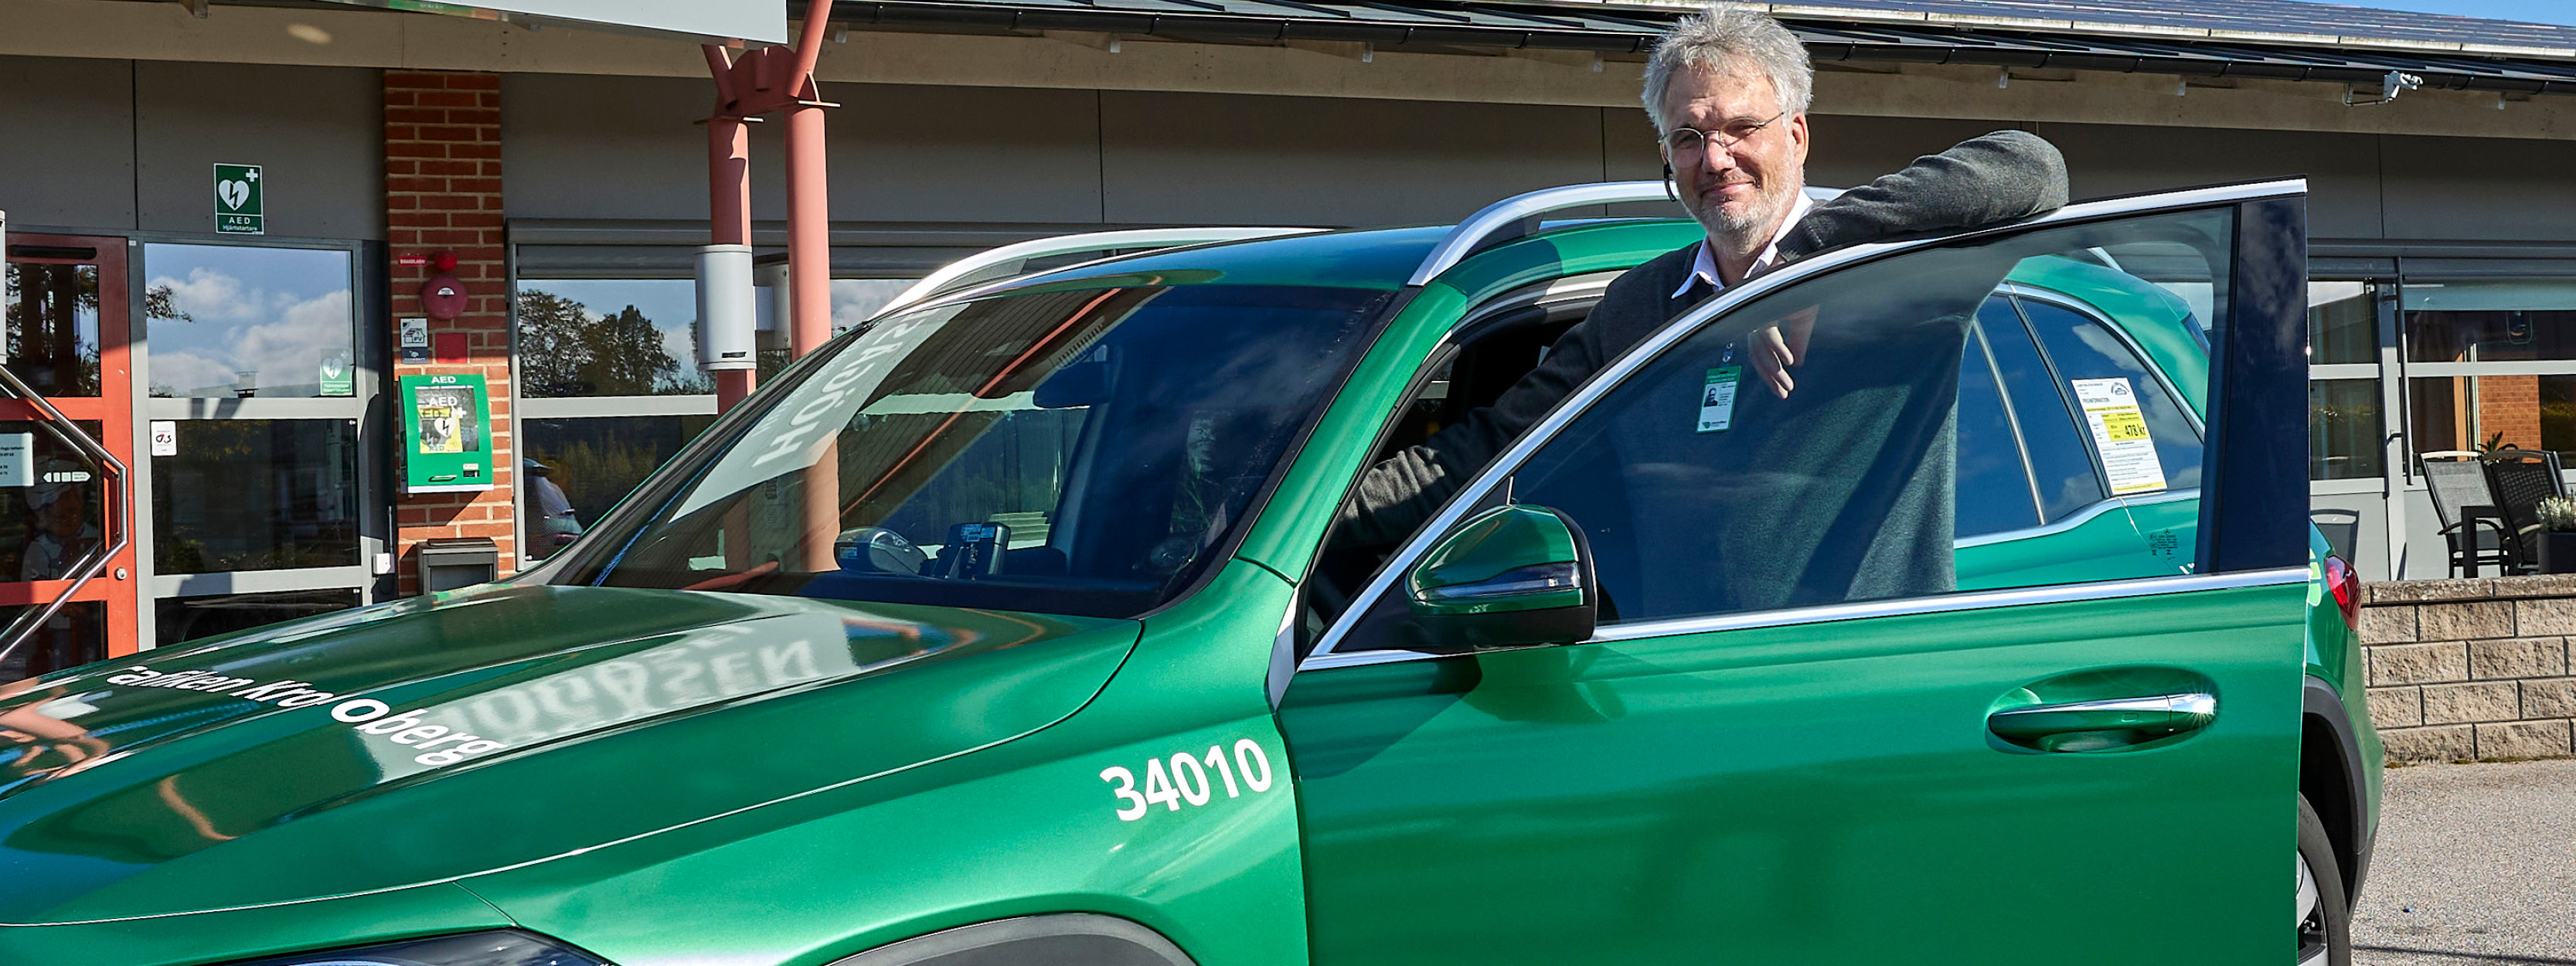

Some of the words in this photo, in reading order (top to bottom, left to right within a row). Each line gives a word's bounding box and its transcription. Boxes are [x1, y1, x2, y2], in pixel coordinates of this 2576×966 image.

[431, 376, 457, 384] AED
[428, 396, 458, 406] AED
[2125, 425, 2139, 437] 478
[1098, 738, 1273, 821] 34010
